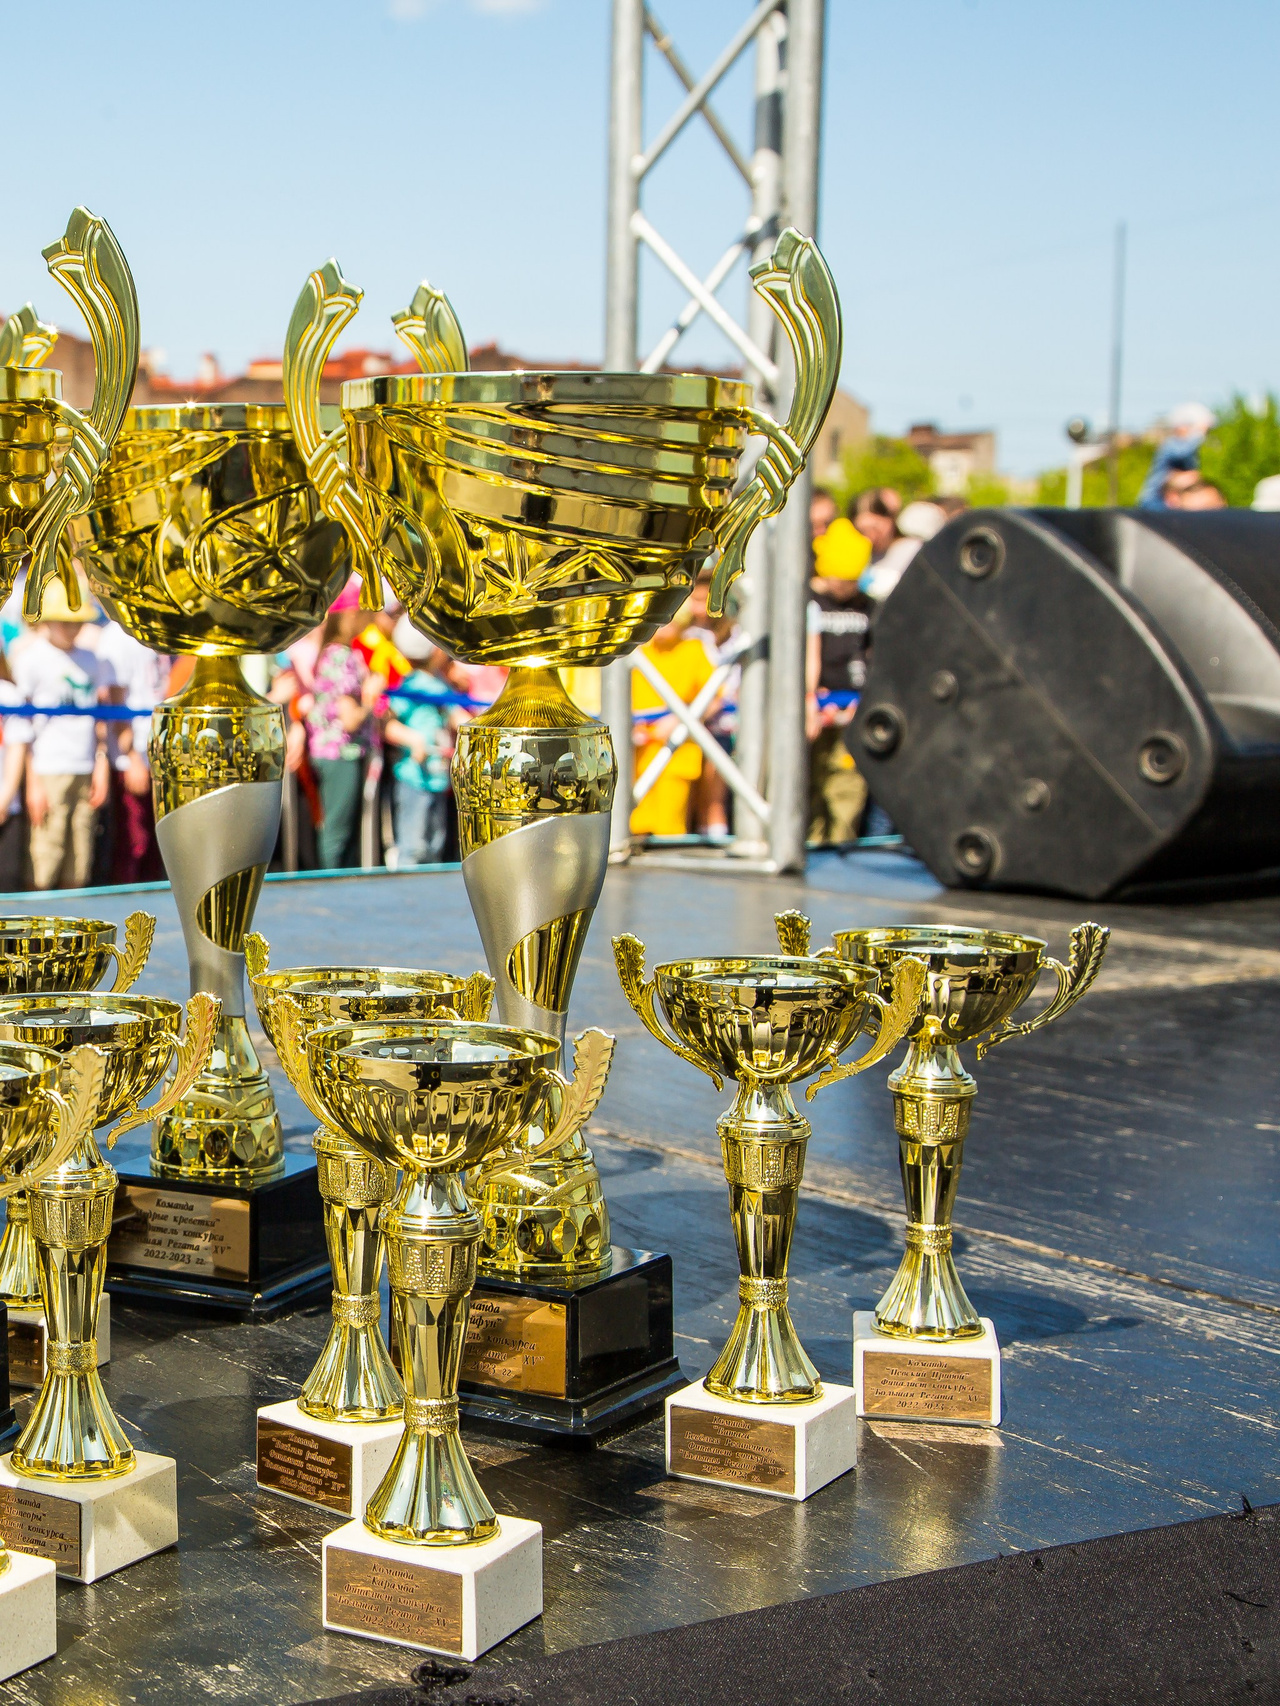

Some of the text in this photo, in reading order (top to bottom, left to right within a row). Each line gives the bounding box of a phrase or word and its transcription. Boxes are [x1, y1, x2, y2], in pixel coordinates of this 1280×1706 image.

[156, 1198, 194, 1211] Команда
[183, 1229, 224, 1242] конкурса
[167, 1239, 200, 1252] Регата
[144, 1249, 192, 1265] 2022-2023
[487, 1335, 537, 1351] конкурса
[907, 1359, 948, 1369] Команда
[880, 1378, 975, 1394] Финалист конкурса
[870, 1387, 915, 1398] “Большая
[920, 1391, 954, 1401] Регата
[712, 1416, 751, 1430] Команда
[688, 1441, 776, 1466] Финалист конкурса
[724, 1458, 757, 1472] Регата
[6, 1493, 41, 1509] Команда
[28, 1524, 65, 1539] конкурса
[17, 1532, 46, 1547] Регата
[372, 1563, 414, 1580] Команда
[367, 1575, 420, 1594] “Карамба”
[344, 1583, 442, 1613] Финалист конкурса
[333, 1593, 380, 1612] “Большая
[385, 1605, 420, 1621] Регата
